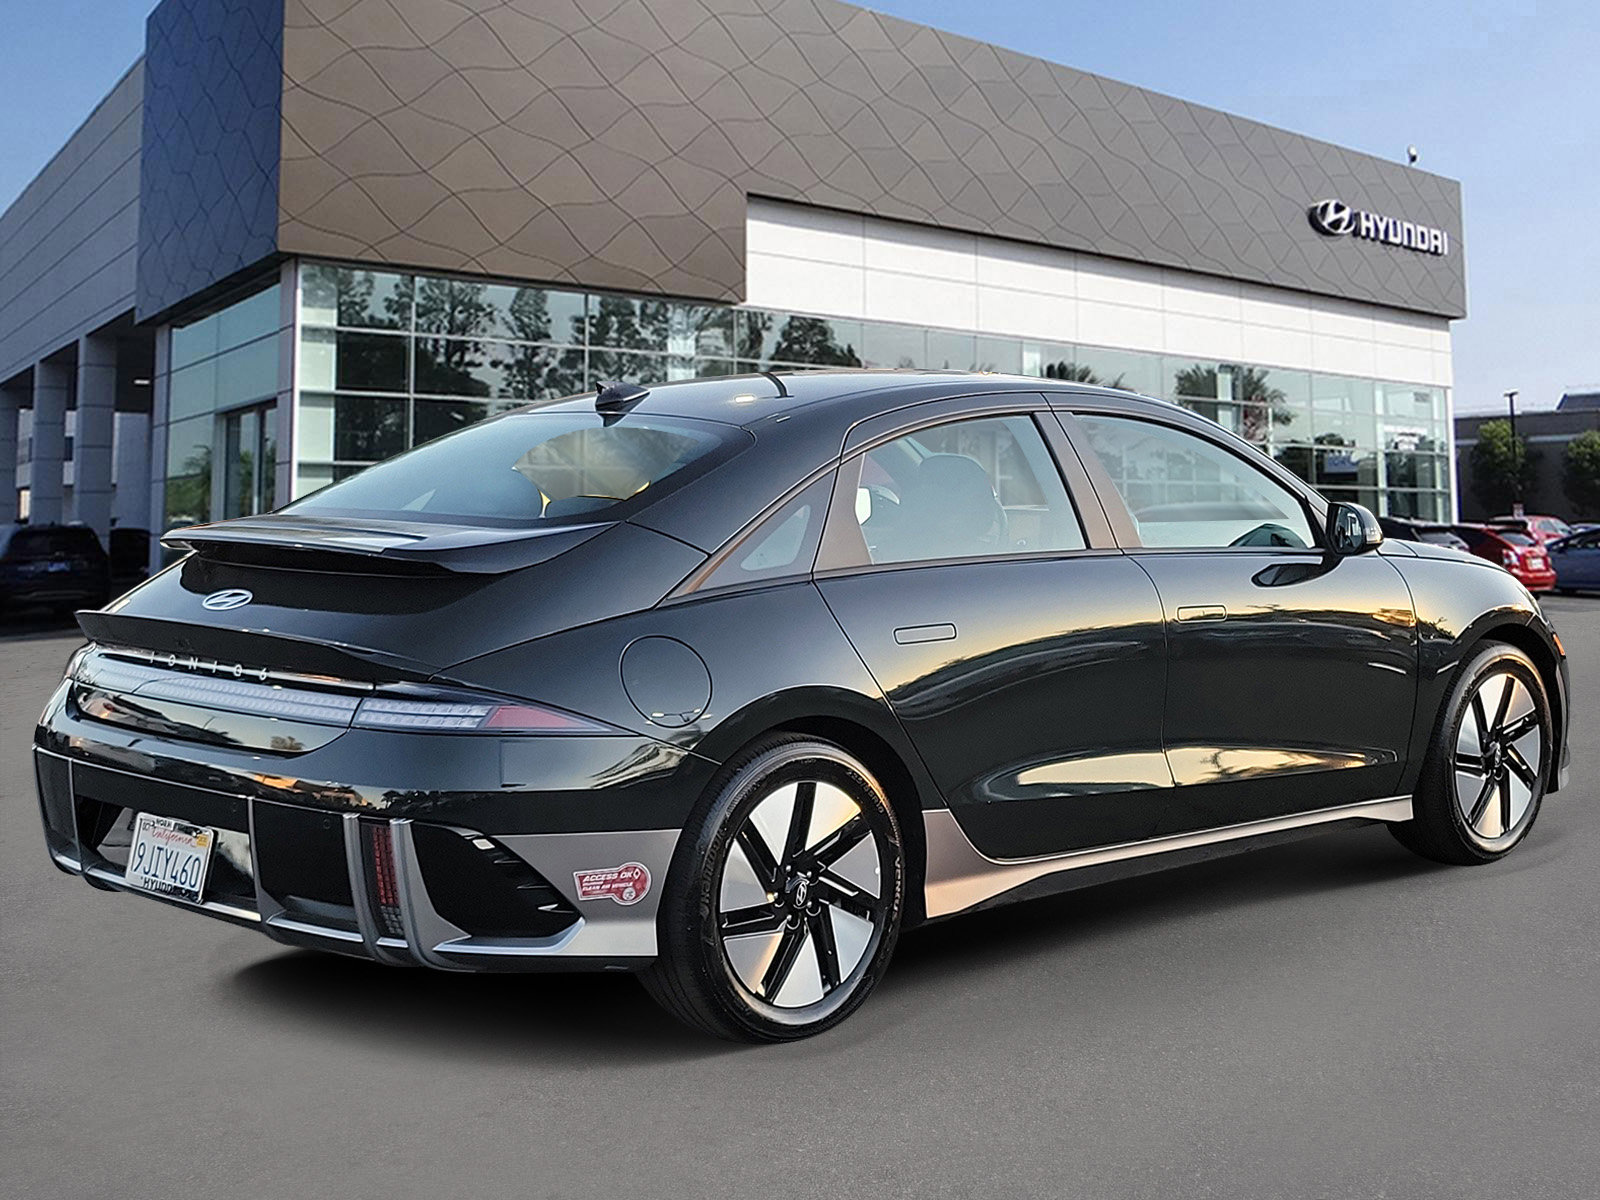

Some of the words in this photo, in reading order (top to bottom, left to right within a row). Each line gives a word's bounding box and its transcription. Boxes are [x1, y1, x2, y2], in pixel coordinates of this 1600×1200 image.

[1360, 211, 1449, 255] HYUNDAI
[150, 651, 242, 677] IONIQ
[259, 668, 267, 681] 6
[583, 873, 618, 882] ACCESS
[620, 871, 633, 879] OK
